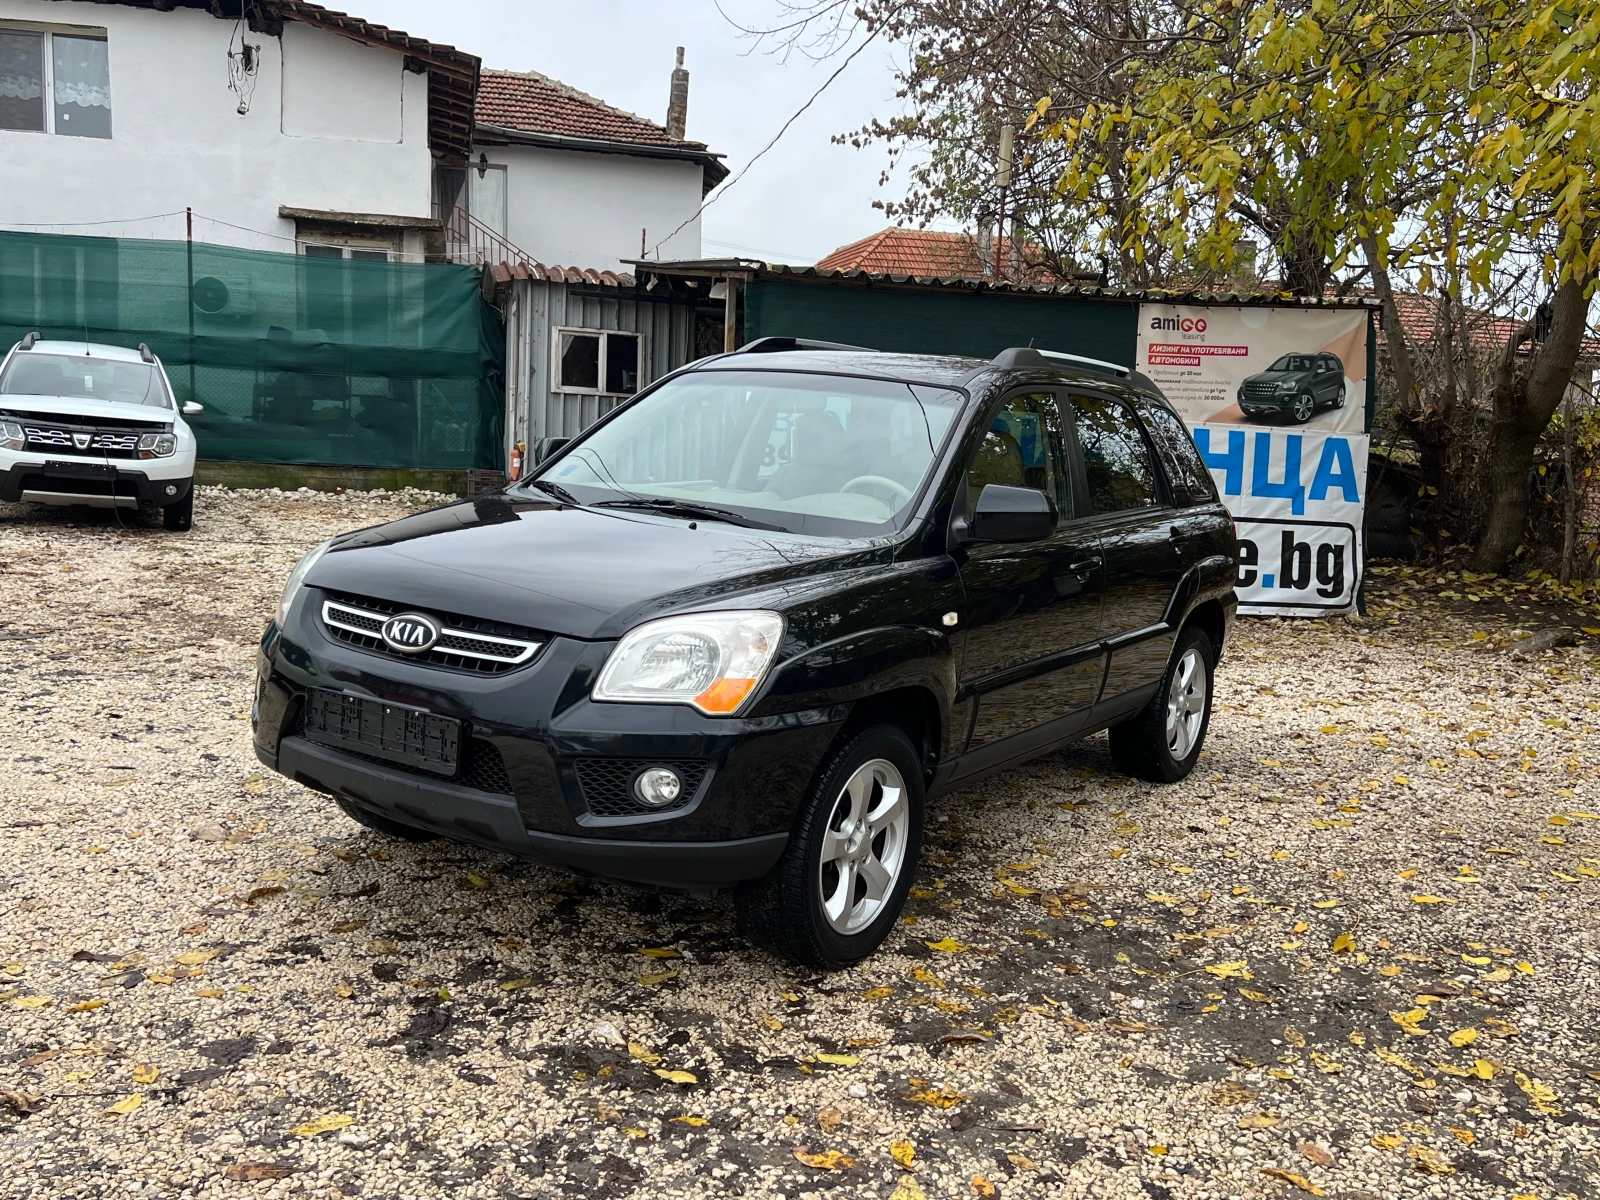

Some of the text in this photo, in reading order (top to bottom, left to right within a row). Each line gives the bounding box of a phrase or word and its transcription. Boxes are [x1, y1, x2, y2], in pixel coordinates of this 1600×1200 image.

[1181, 332, 1206, 342] leasing
[1150, 345, 1180, 353] ЛИЗИНГ
[1190, 346, 1247, 355] УПОТРЕБЯВАНИ
[1149, 356, 1199, 365] АВТОМОБИЛИ
[388, 620, 425, 646] KIA
